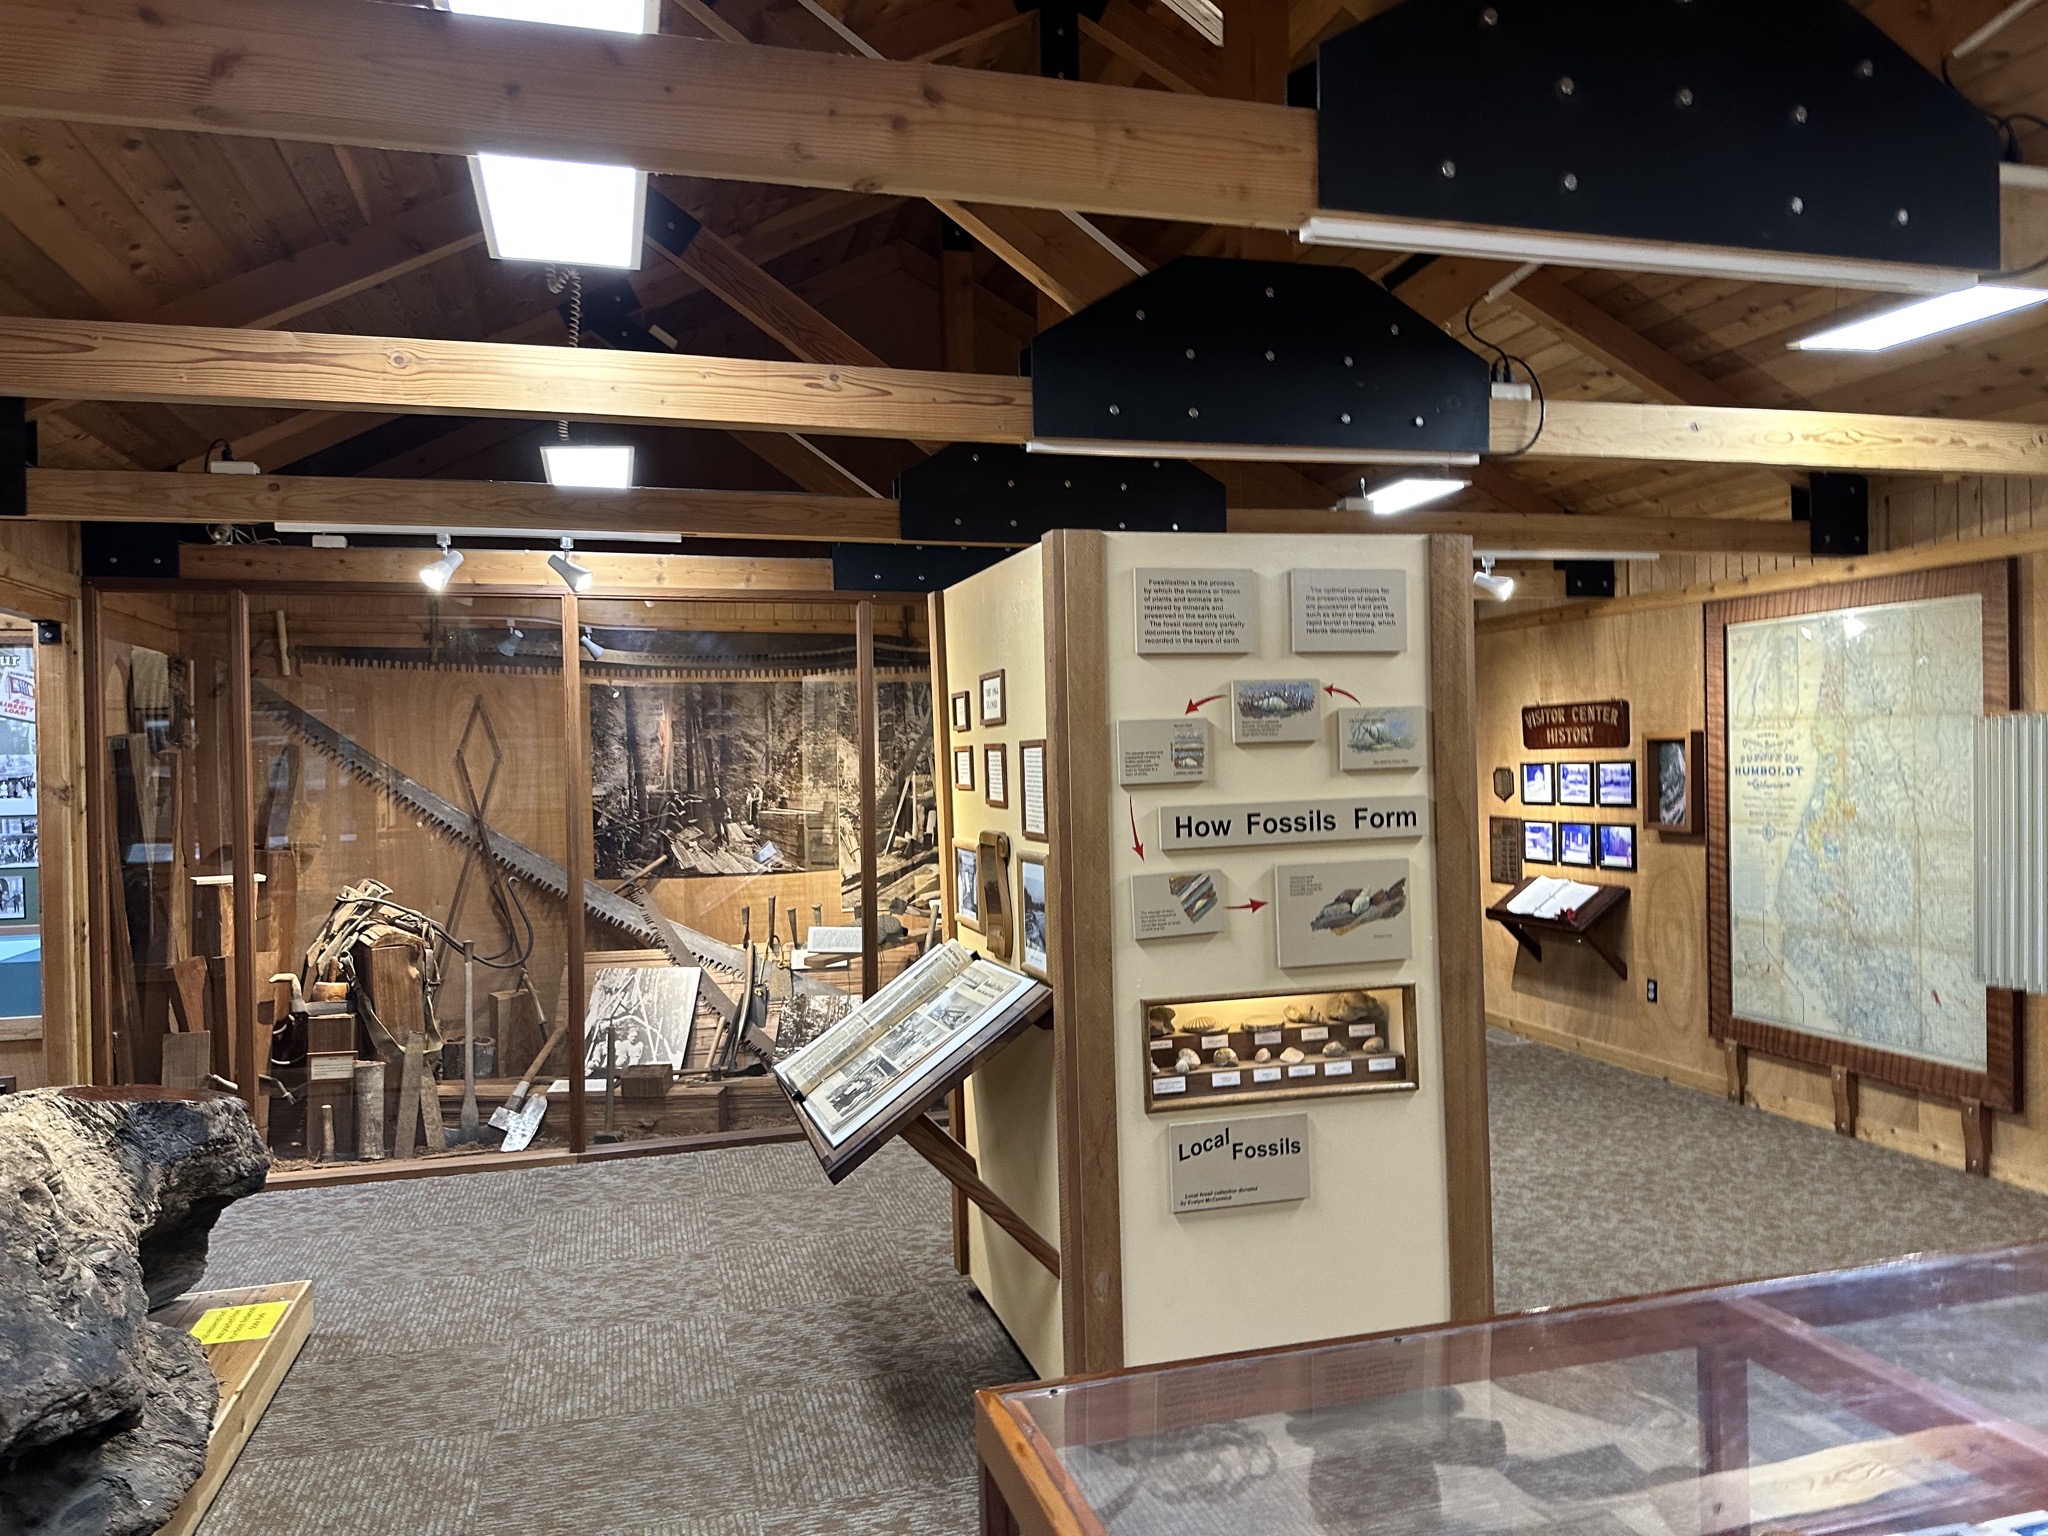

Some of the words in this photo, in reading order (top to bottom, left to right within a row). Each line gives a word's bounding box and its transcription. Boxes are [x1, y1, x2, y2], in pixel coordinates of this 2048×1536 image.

[0, 701, 34, 712] LIBERTY
[4, 707, 27, 716] LOAN
[1525, 707, 1565, 730] VISITOR
[1571, 704, 1619, 727] CENTER
[1546, 725, 1594, 744] HISTORY
[1734, 765, 1803, 777] HUMBOLDT
[1174, 815, 1232, 838] How
[1246, 809, 1337, 835] Fossils
[1354, 807, 1418, 830] Form
[1178, 1127, 1230, 1162] Local
[1232, 1137, 1302, 1160] Fossils
